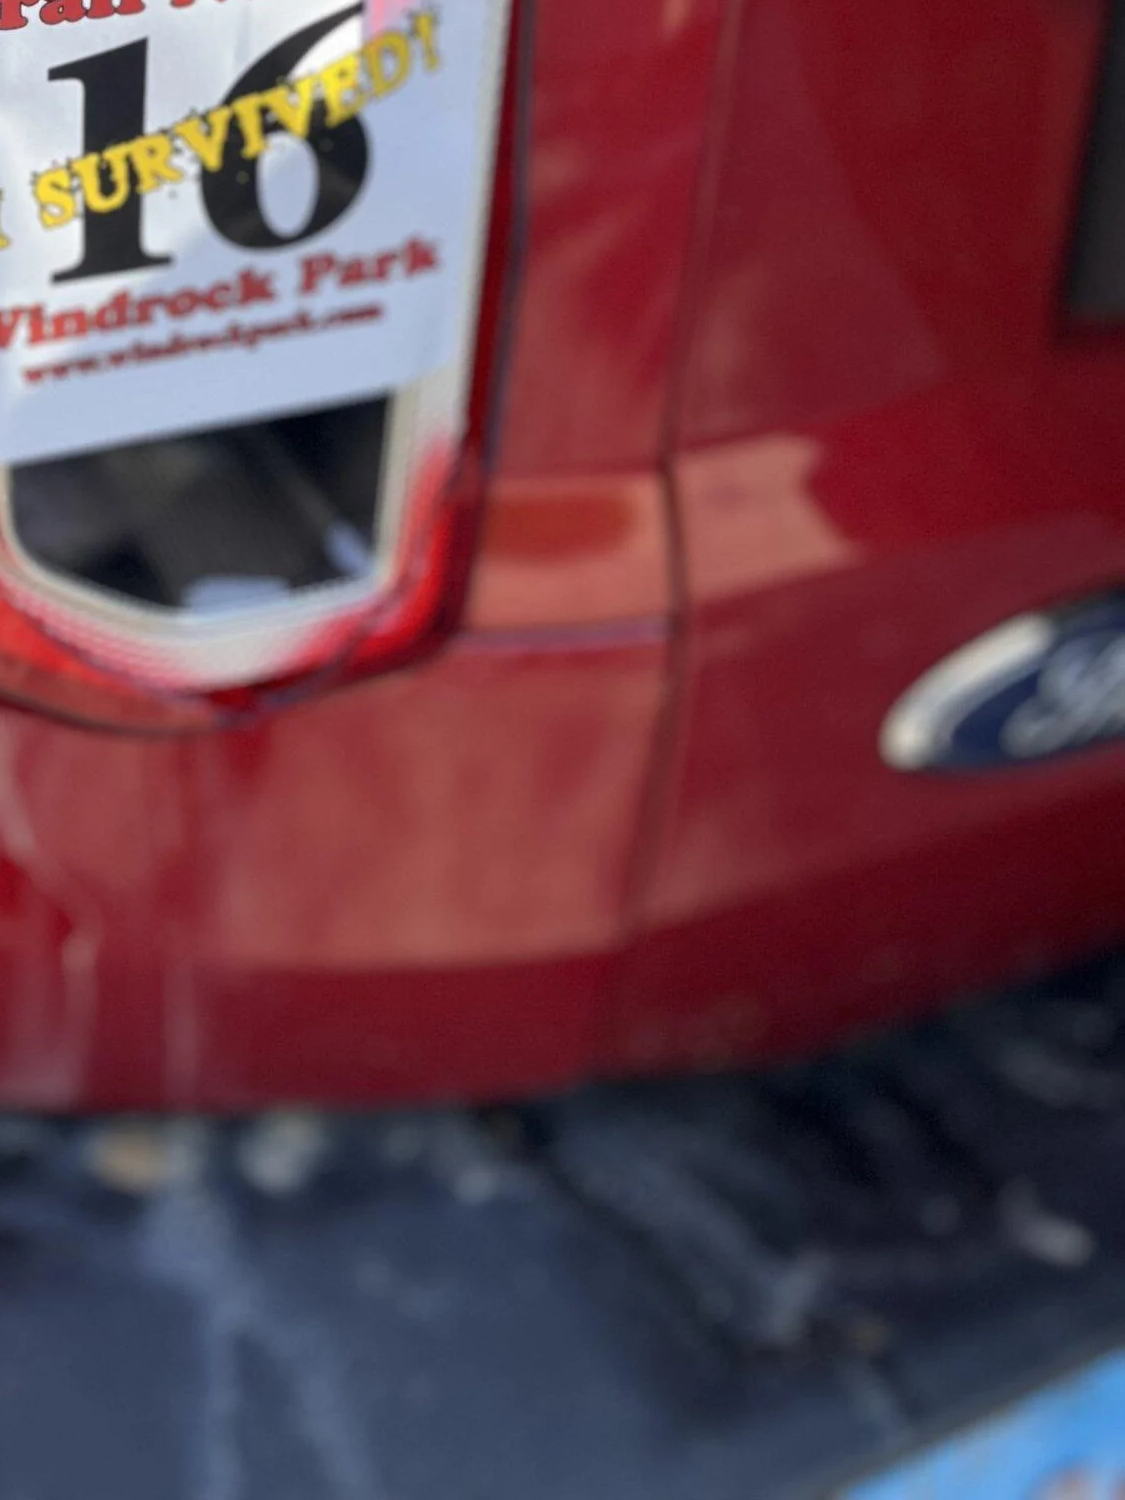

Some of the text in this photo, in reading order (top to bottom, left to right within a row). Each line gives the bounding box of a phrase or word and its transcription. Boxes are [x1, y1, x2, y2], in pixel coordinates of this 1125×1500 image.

[33, 9, 443, 230] SURVIVED!
[47, 0, 369, 286] 16
[299, 236, 438, 295] Park
